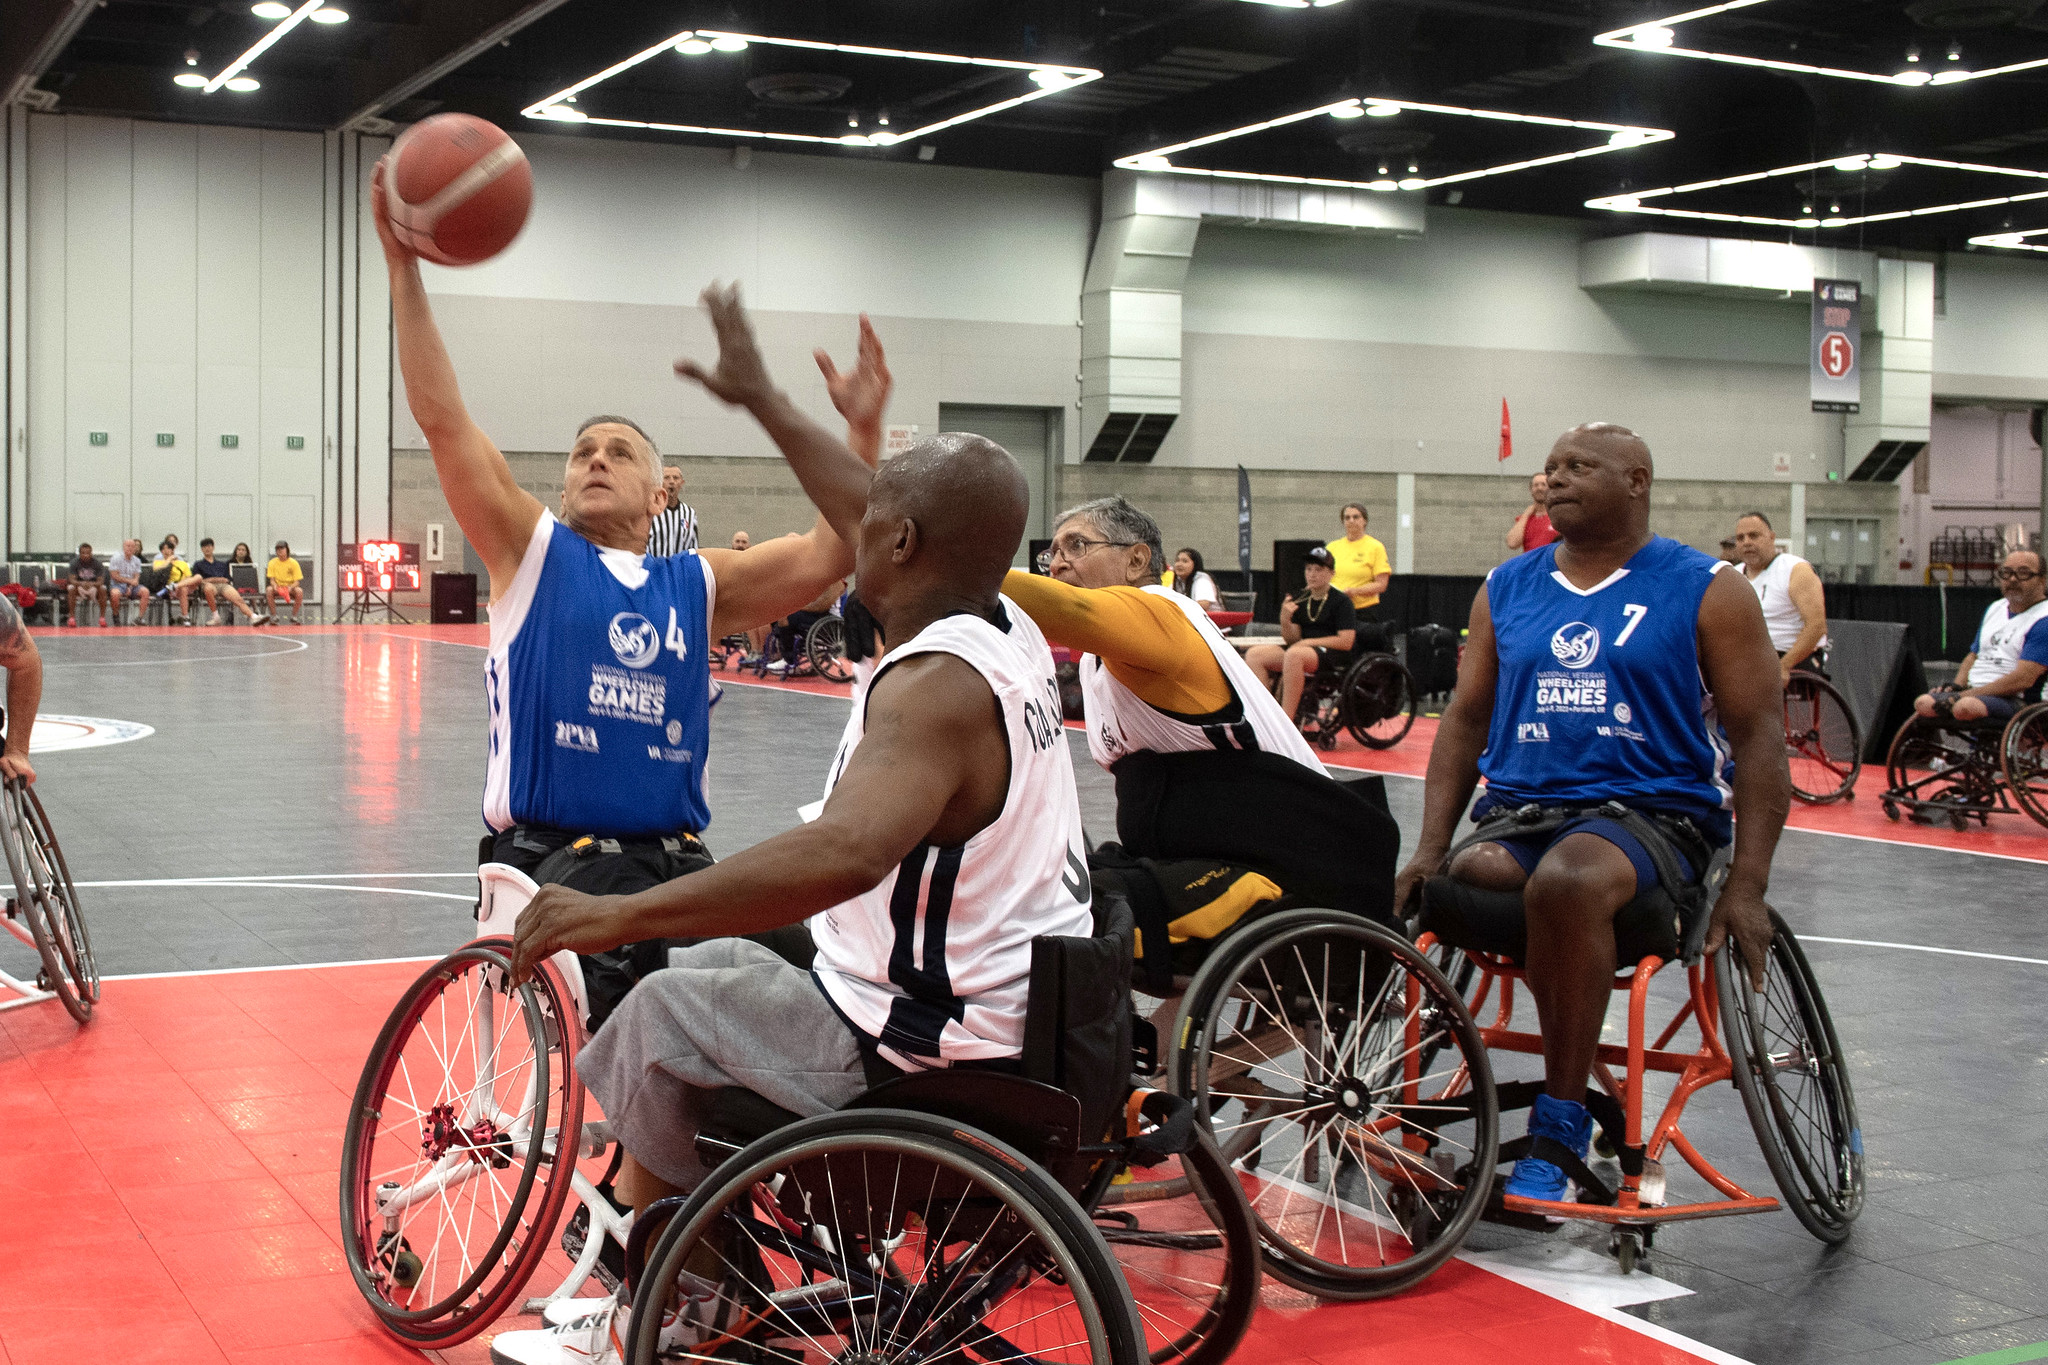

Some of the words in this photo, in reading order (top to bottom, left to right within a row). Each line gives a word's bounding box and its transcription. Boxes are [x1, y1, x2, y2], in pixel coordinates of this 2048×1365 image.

[1830, 338, 1842, 373] 5
[339, 564, 362, 572] HOME
[394, 564, 419, 572] GUEST
[347, 571, 363, 588] 11
[408, 570, 419, 588] 7
[665, 605, 687, 662] 4
[1613, 603, 1648, 647] 7
[1537, 671, 1570, 679] NATIONAL
[1537, 678, 1607, 689] WHEELCHAIR
[588, 684, 666, 718] GAMES
[1536, 688, 1607, 706] GAMES
[1596, 726, 1611, 736] VA
